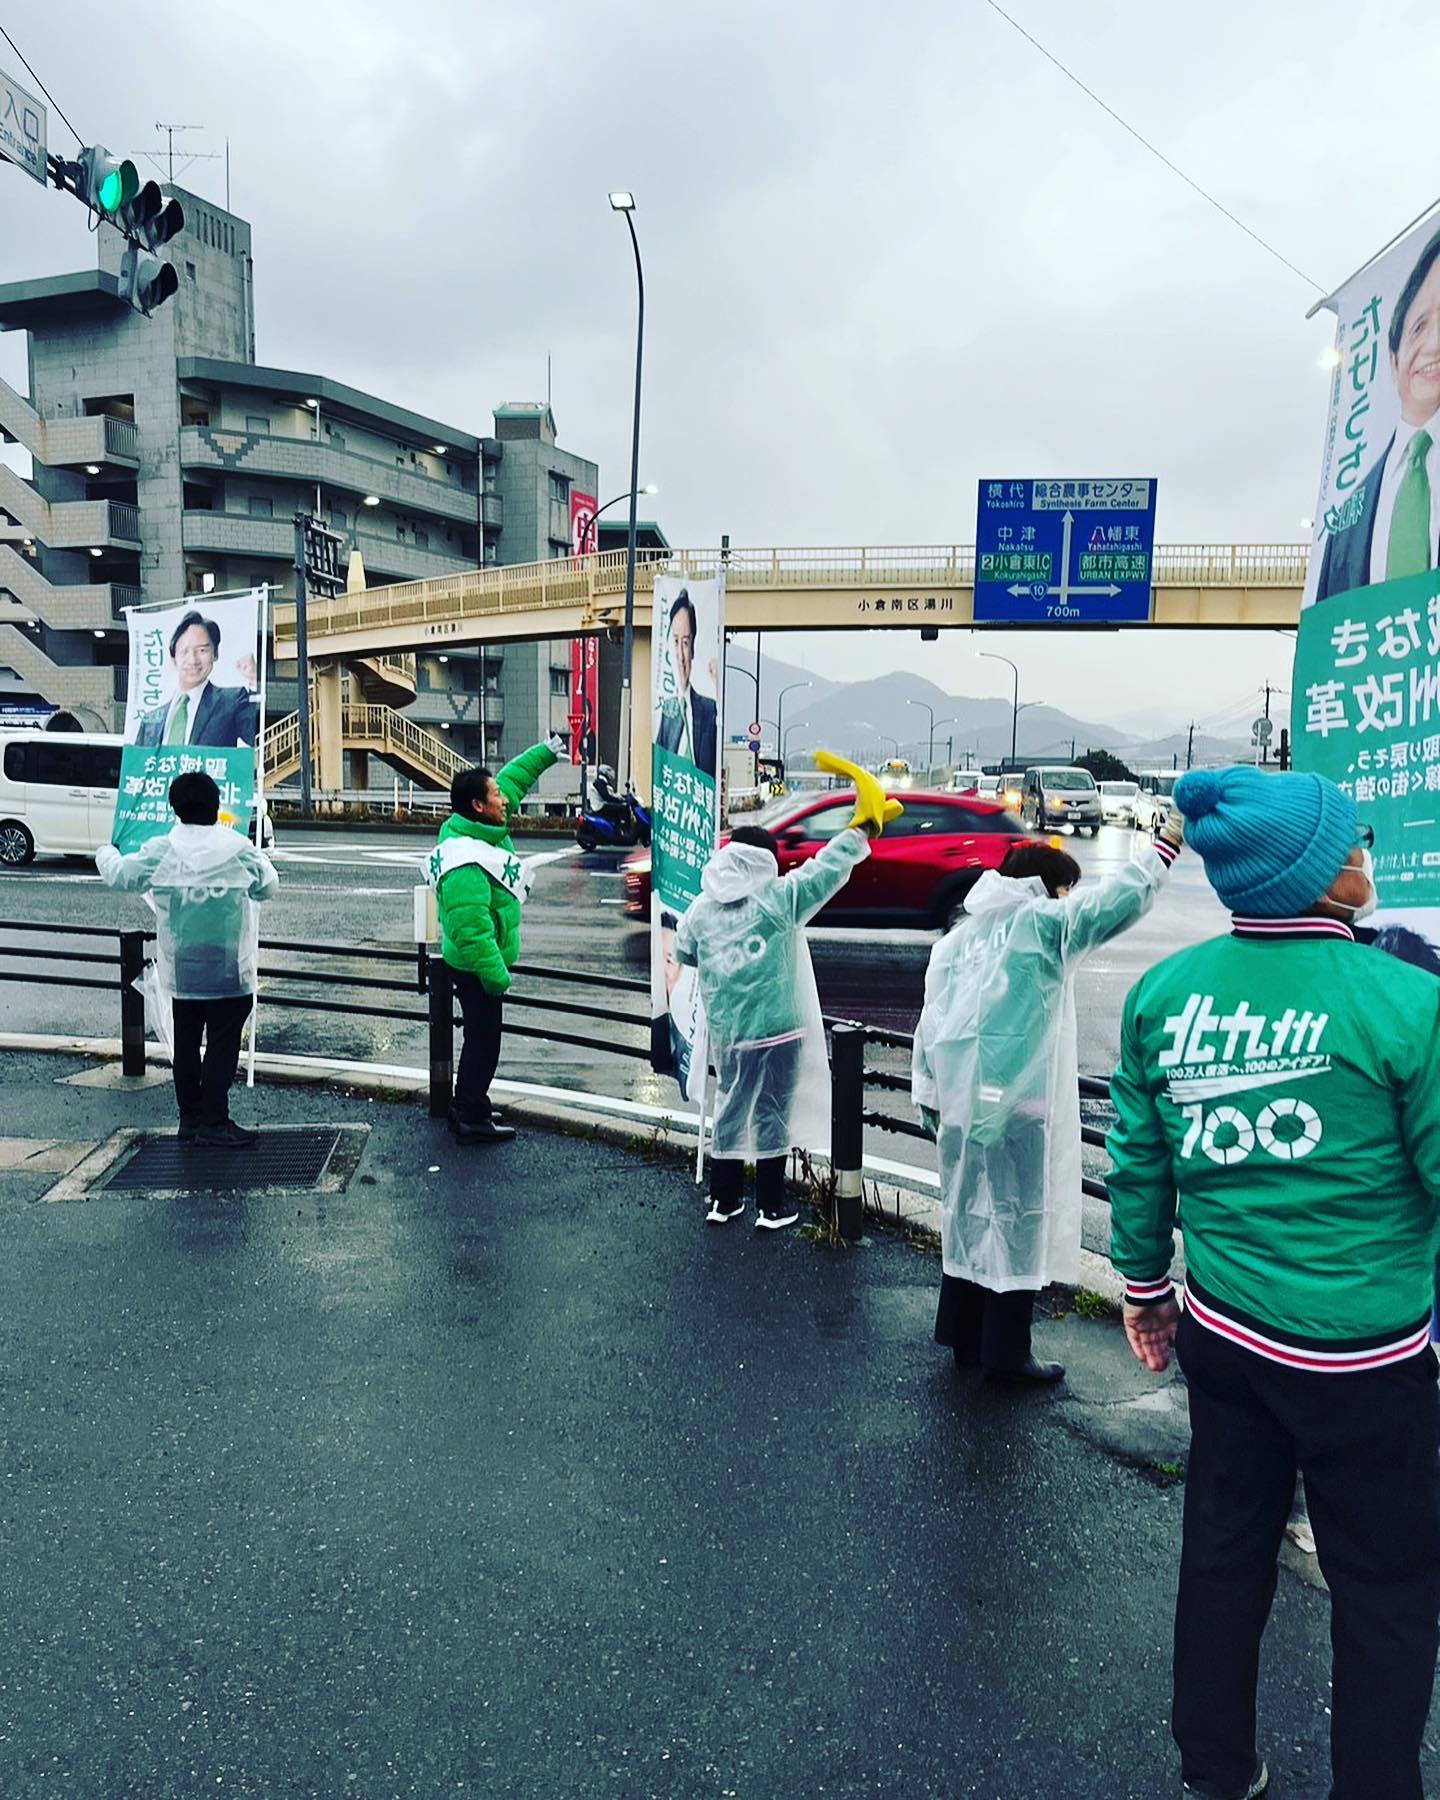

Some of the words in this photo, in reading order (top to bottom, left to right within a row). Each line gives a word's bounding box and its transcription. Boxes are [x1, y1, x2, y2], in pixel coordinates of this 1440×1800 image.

[4, 90, 39, 144] 入口
[988, 482, 1025, 499] 横代
[1035, 482, 1146, 499] 総合農事センター
[1084, 499, 1107, 508] Farm
[1110, 499, 1140, 508] Center
[998, 525, 1036, 542] 中津
[1091, 525, 1141, 542] 八幡東
[998, 542, 1034, 551] Nakatsu
[1081, 555, 1146, 570] 都市高速
[1080, 570, 1111, 579] URBAN
[1114, 570, 1146, 579] EXPWY
[1033, 585, 1045, 596] 10
[1046, 606, 1080, 617] 700m
[1158, 993, 1329, 1067] 北九州
[1180, 1098, 1323, 1166] 100
